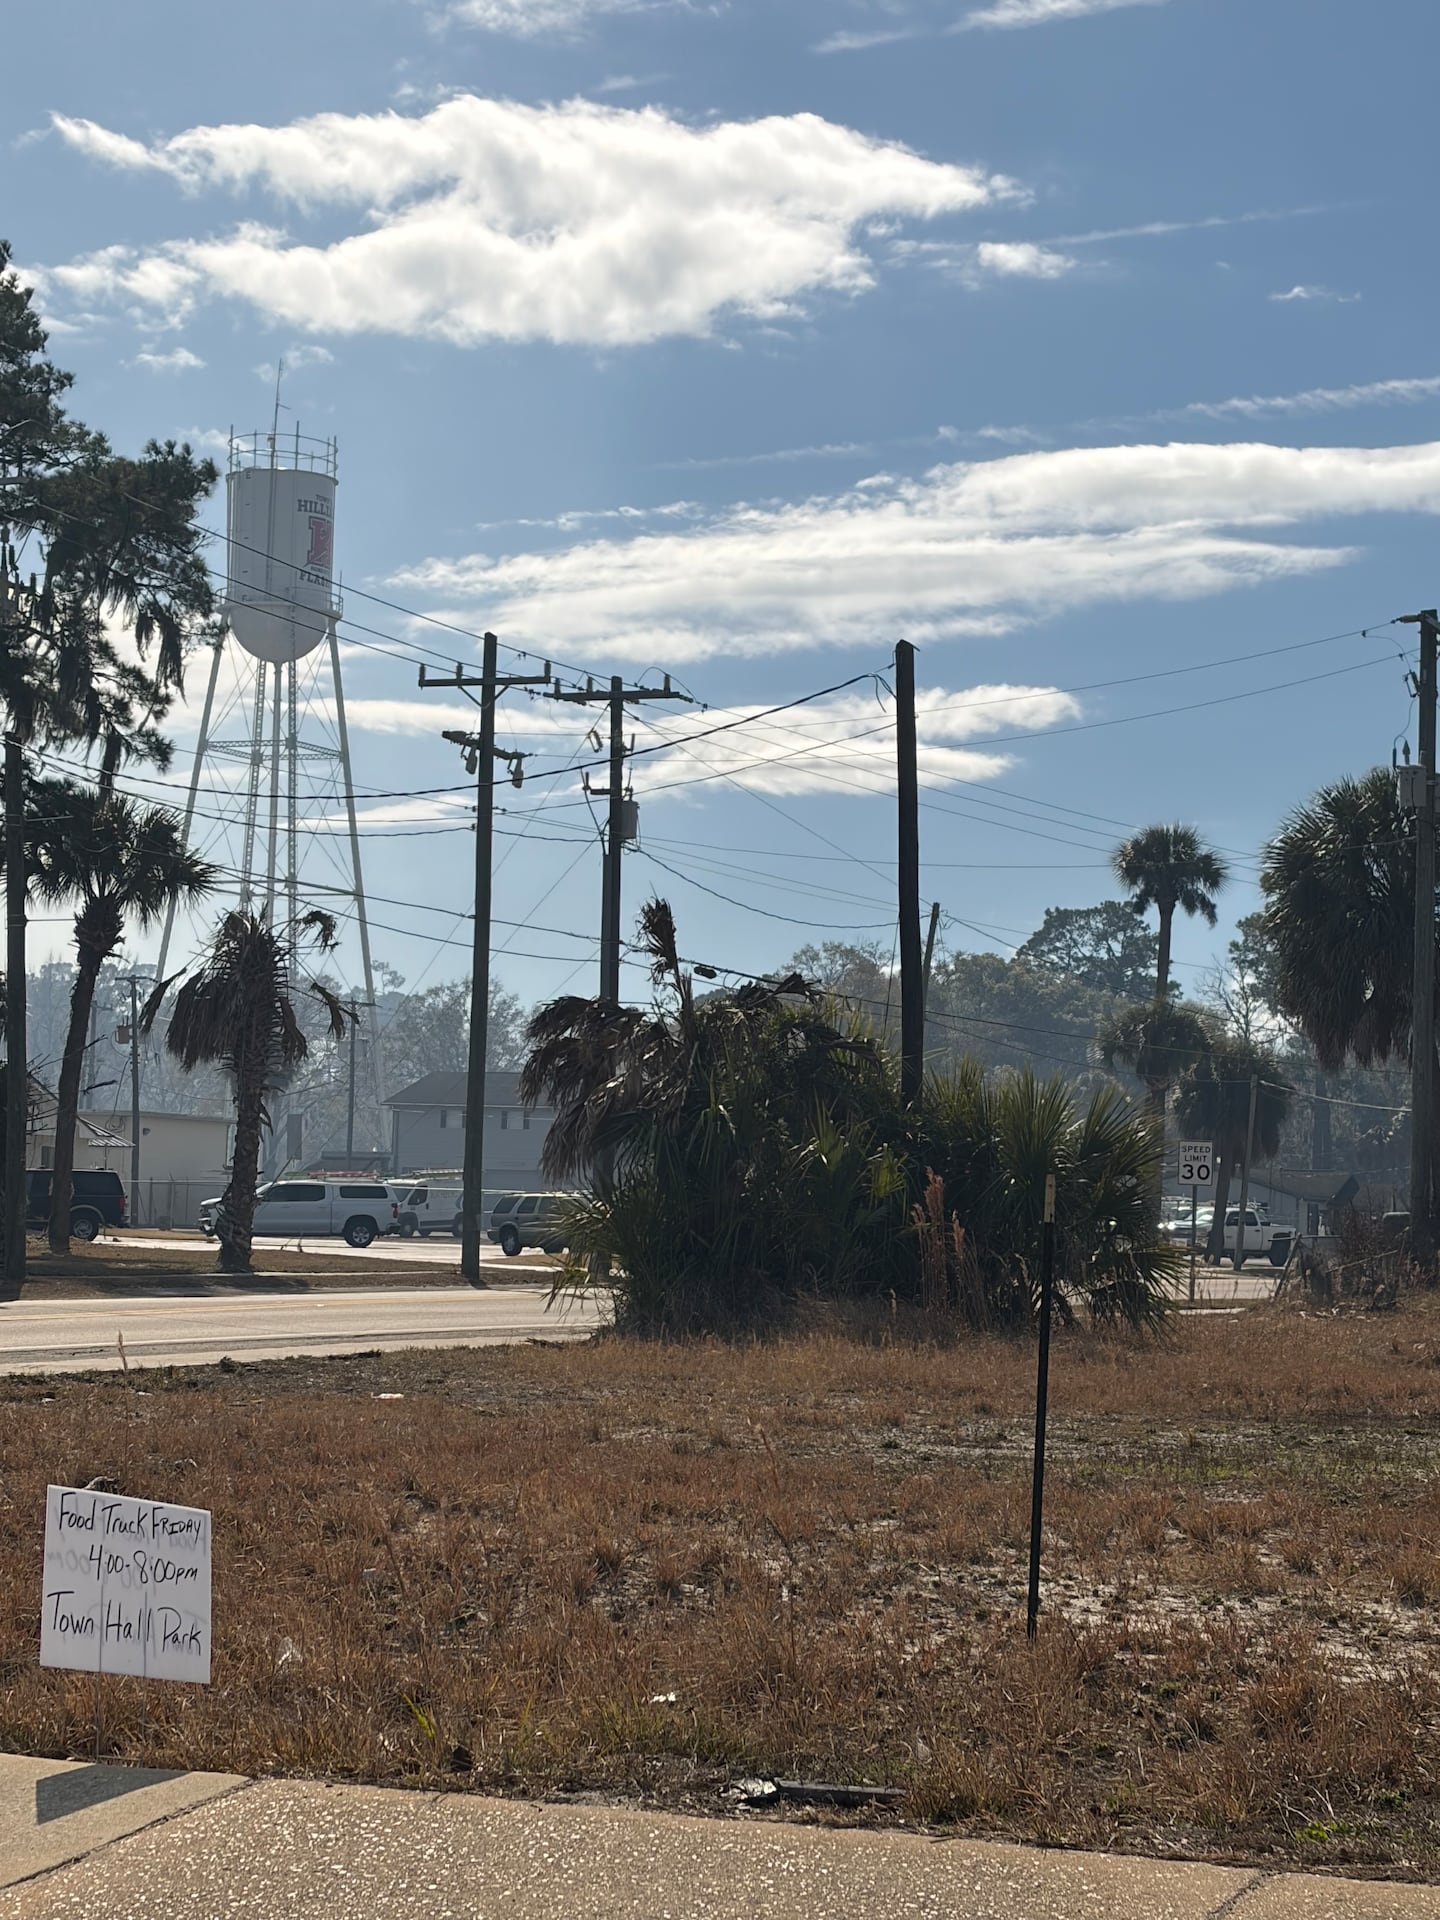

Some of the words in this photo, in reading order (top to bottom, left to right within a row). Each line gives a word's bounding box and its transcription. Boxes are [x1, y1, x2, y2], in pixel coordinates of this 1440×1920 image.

[1180, 1145, 1211, 1153] SPEED
[1184, 1154, 1207, 1162] LIMIT
[1181, 1164, 1210, 1180] 30
[59, 1492, 96, 1531] Food
[102, 1503, 148, 1538] Truck
[152, 1506, 201, 1544] FRIDAY
[47, 1591, 94, 1635] Town
[105, 1599, 153, 1643] Hall
[157, 1606, 202, 1656] Park
